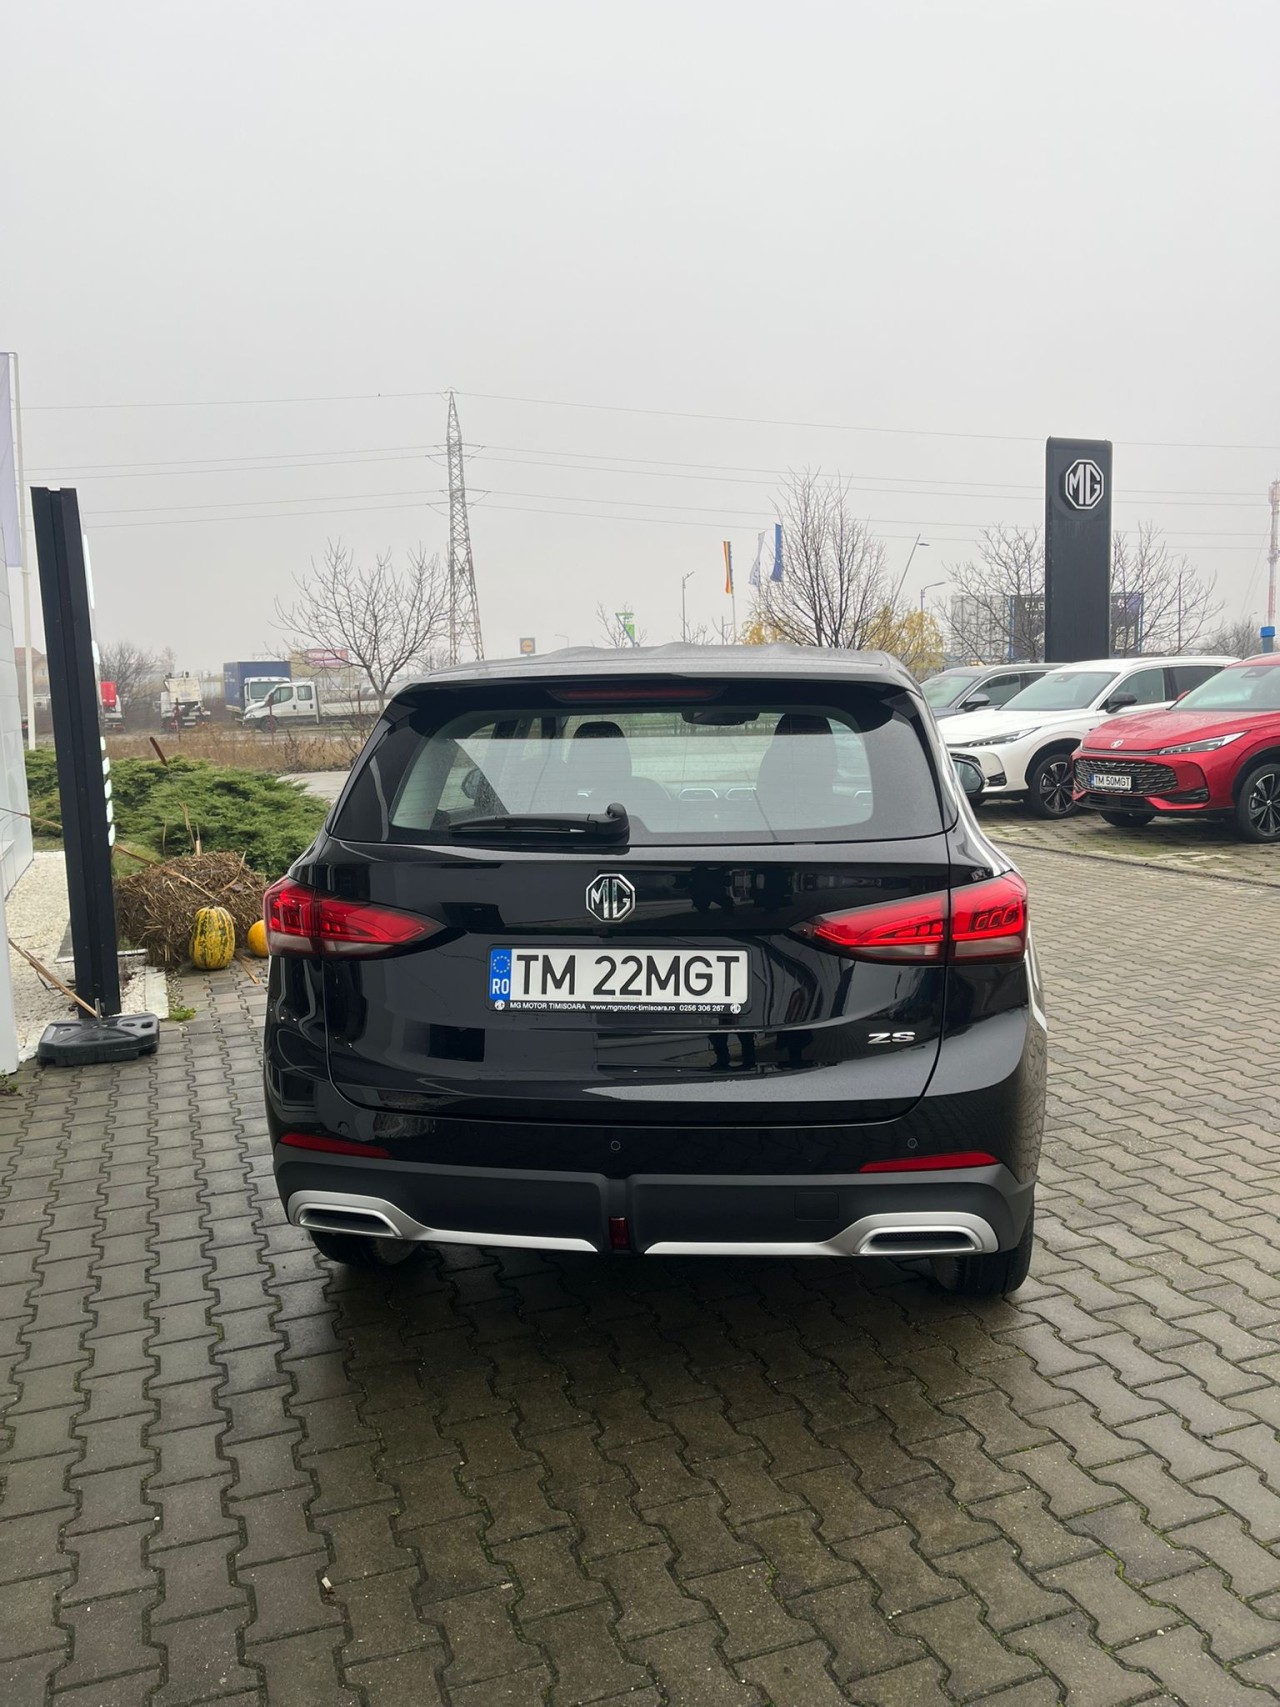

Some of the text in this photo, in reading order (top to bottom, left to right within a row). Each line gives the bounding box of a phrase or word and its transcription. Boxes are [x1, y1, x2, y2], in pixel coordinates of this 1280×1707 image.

[1069, 463, 1101, 505] MG
[1095, 776, 1104, 785] TM
[1106, 776, 1130, 787] 50MGT
[590, 878, 631, 919] MG
[516, 954, 740, 997] TM 22MGT
[492, 978, 510, 995] RO
[590, 1004, 675, 1012] www.mgmotor-timisoara.ro
[698, 1004, 710, 1012] 306
[867, 1031, 915, 1045] ZS
